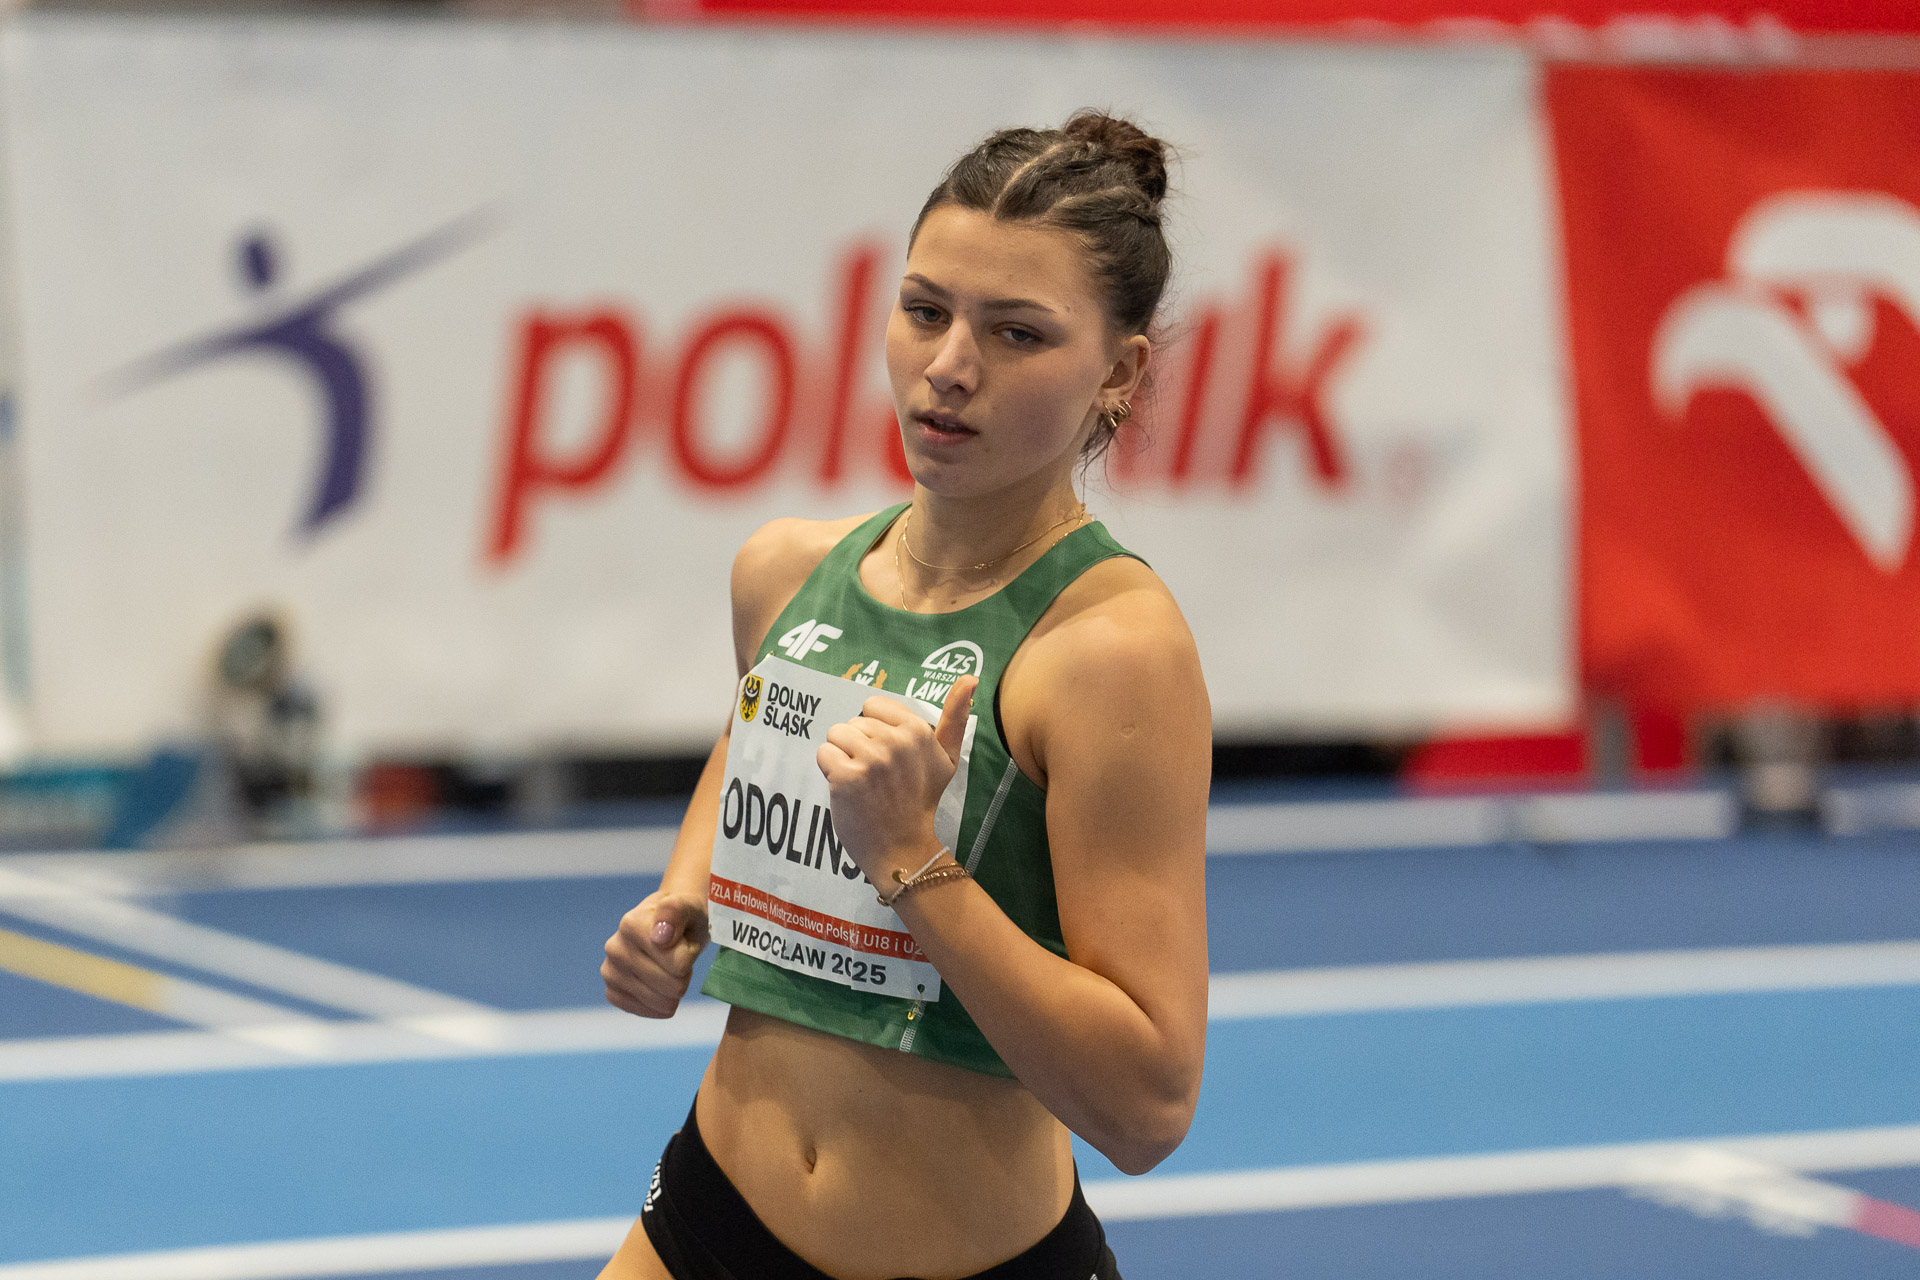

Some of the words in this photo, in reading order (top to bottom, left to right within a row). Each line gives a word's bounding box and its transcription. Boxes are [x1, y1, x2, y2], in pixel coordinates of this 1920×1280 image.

[482, 240, 1366, 568] polik
[767, 682, 822, 717] DOLNY
[923, 670, 961, 683] WARSZA
[763, 701, 814, 739] ŚLĄSK
[722, 776, 872, 885] ODOLIN
[711, 881, 731, 901] PZLA
[733, 889, 768, 912] Halowe
[769, 901, 824, 934] Mistrzostwa
[826, 923, 860, 945] Polski
[863, 933, 890, 950] U18
[894, 938, 899, 952] i
[903, 940, 924, 956] U2
[732, 919, 826, 970] WROCŁAW
[831, 952, 887, 985] 2025
